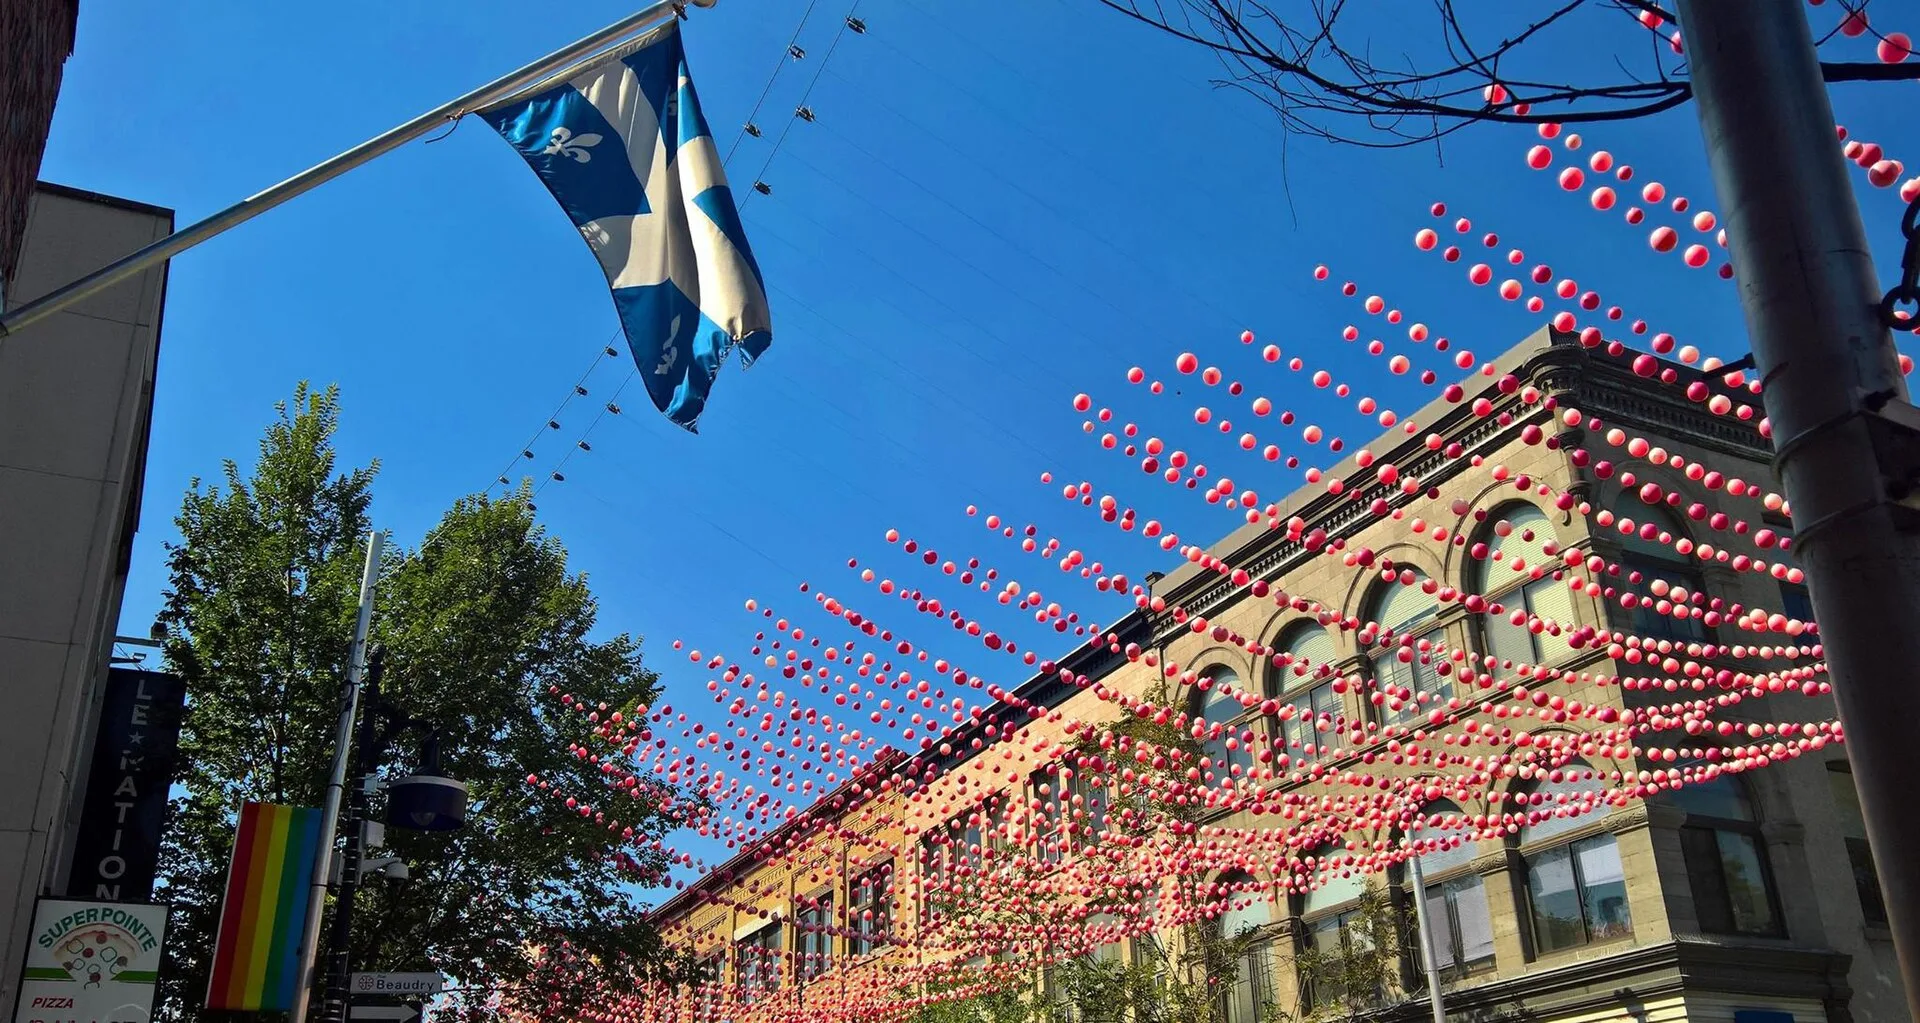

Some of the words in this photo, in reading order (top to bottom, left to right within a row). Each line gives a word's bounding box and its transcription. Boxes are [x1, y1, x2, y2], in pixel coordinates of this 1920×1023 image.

[131, 679, 153, 726] LE
[376, 979, 435, 992] Beaudry
[31, 997, 74, 1009] PIZZA
